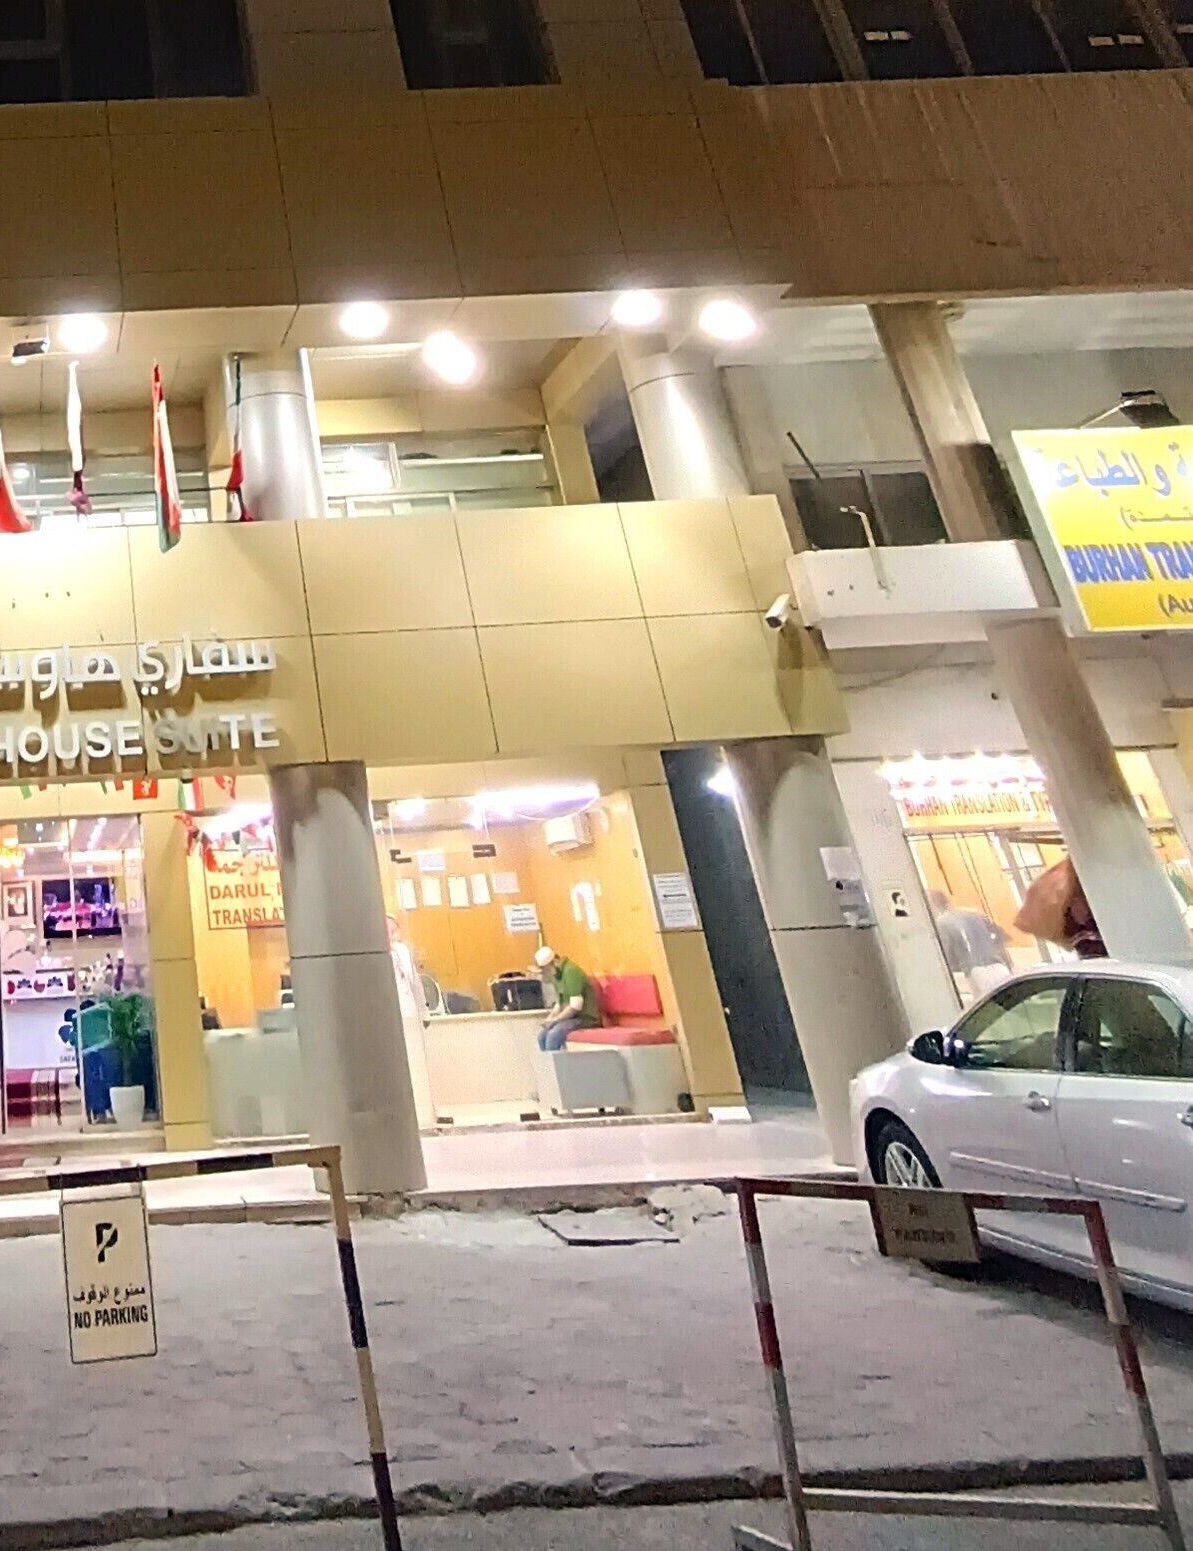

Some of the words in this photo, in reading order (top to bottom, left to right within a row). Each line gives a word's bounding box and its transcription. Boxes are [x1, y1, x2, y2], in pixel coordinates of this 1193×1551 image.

[1063, 543, 1154, 583] BURHAN
[134, 628, 276, 695] سفاري
[154, 712, 280, 754] SUITE
[950, 792, 1021, 816] TRANSLATION
[210, 882, 271, 900] DARUL
[73, 1283, 109, 1305] الوقوف
[114, 1283, 146, 1305] ممنوع
[74, 1311, 91, 1329] NO
[95, 1304, 148, 1326] PARKING
